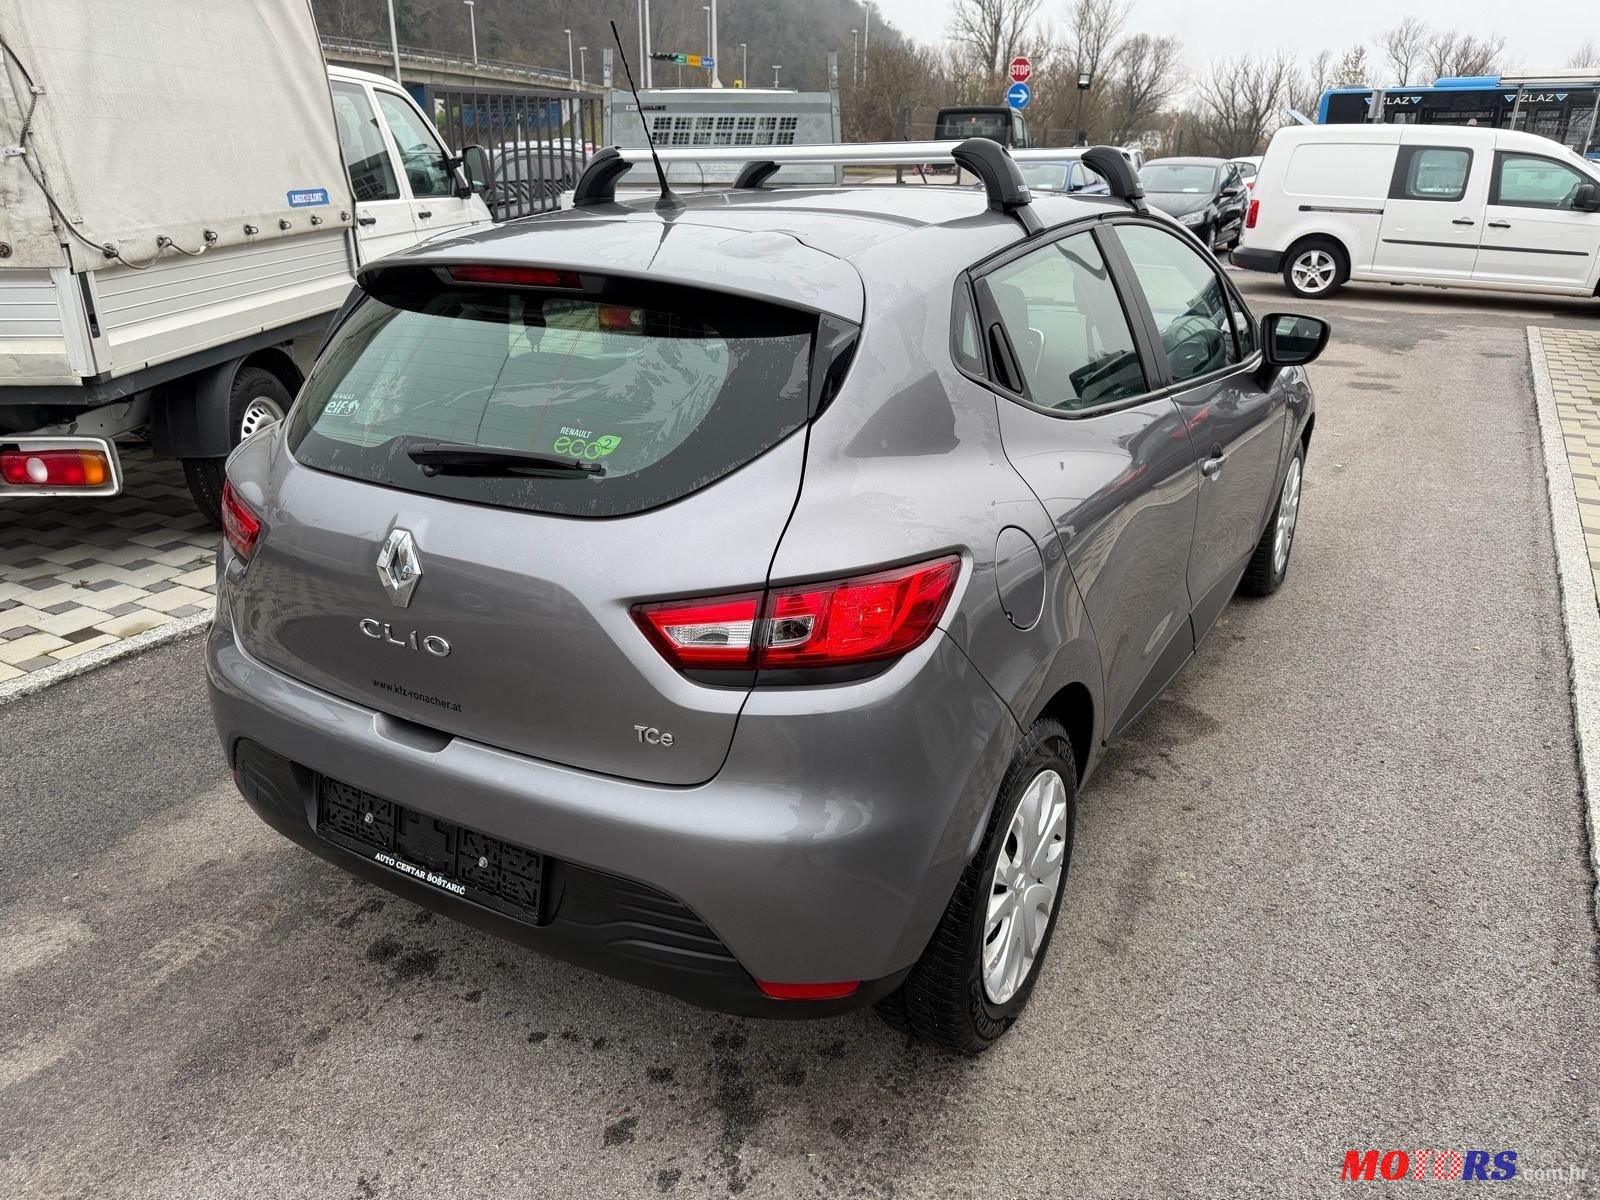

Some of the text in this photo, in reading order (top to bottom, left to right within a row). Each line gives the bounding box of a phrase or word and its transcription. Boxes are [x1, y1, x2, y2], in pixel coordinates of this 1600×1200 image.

[1011, 64, 1030, 76] STOP
[1519, 93, 1555, 103] ZLAZ
[560, 426, 592, 439] RENAULT
[360, 618, 451, 657] CLIO
[373, 679, 462, 713] www.kfz-ronacher.at
[633, 724, 674, 747] TCe
[374, 852, 466, 895] AUTO CENTAR ŠOŠTARIĆ
